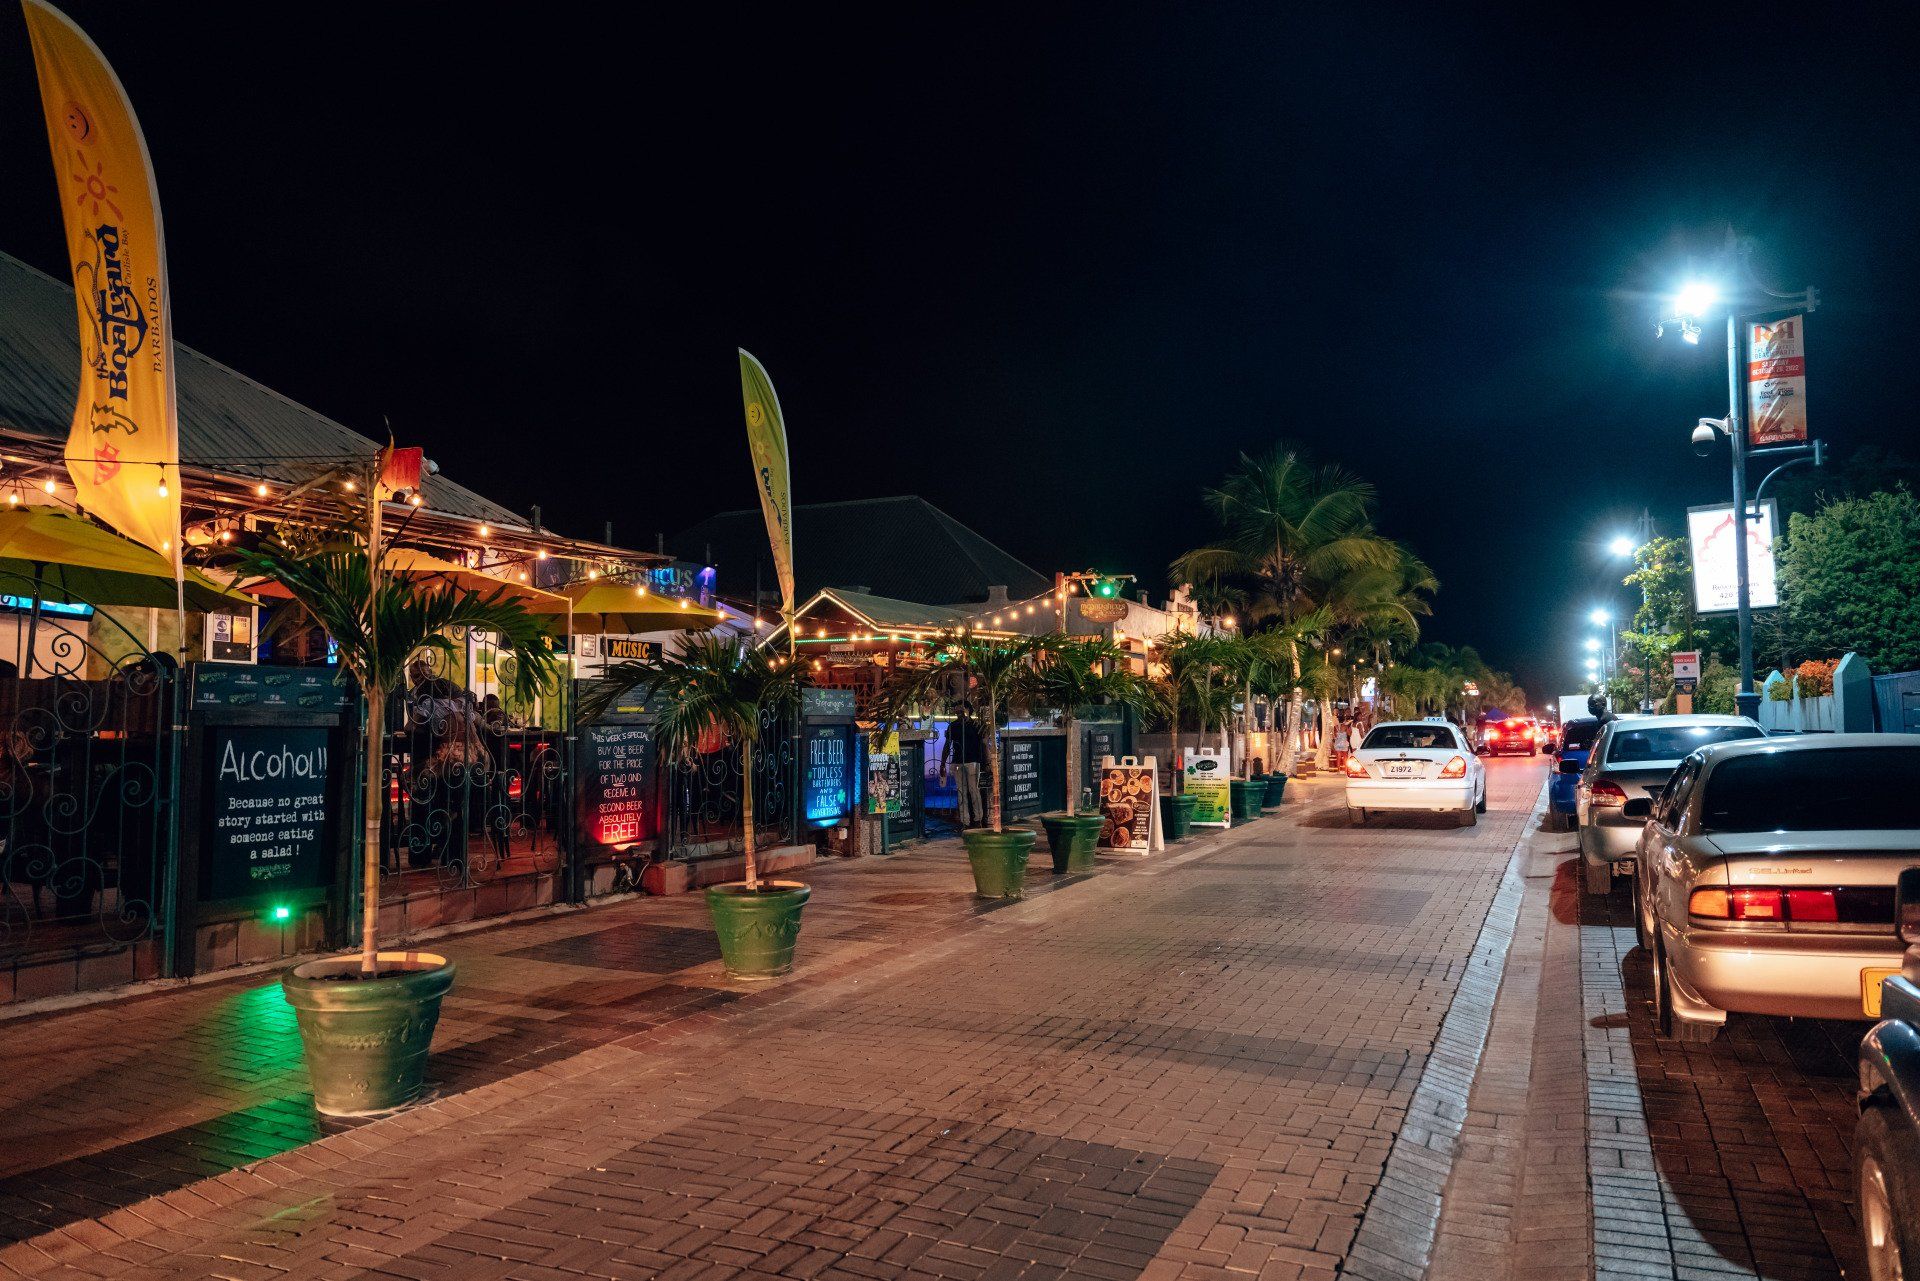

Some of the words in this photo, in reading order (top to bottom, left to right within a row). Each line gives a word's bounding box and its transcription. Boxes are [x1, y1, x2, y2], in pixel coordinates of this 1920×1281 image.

[146, 277, 163, 373] BARBADOS
[611, 640, 650, 659] MUSIC
[597, 746, 612, 756] BUY
[628, 744, 644, 755] BEER
[810, 739, 826, 765] FREE
[828, 739, 845, 765] BEER
[599, 760, 612, 771] FOR
[613, 760, 626, 770] THE
[626, 758, 643, 769] PRICE
[1390, 765, 1412, 773] Z1972
[600, 775, 609, 784] OF
[610, 774, 627, 784] TWO
[811, 767, 843, 780] TOPLESS
[603, 787, 629, 799] RECEIVE
[228, 797, 274, 810] Because
[277, 798, 291, 807] no
[293, 793, 324, 809] great
[599, 803, 626, 814] SECOND
[626, 800, 643, 811] BEER
[816, 794, 837, 808] FALSE
[218, 815, 252, 829] story
[255, 811, 298, 825] started
[301, 809, 325, 822] with
[599, 812, 642, 825] ABSOLUTELY
[230, 831, 275, 844] someone
[278, 828, 315, 841] eating
[603, 821, 639, 842] FREE!
[249, 848, 258, 860] a
